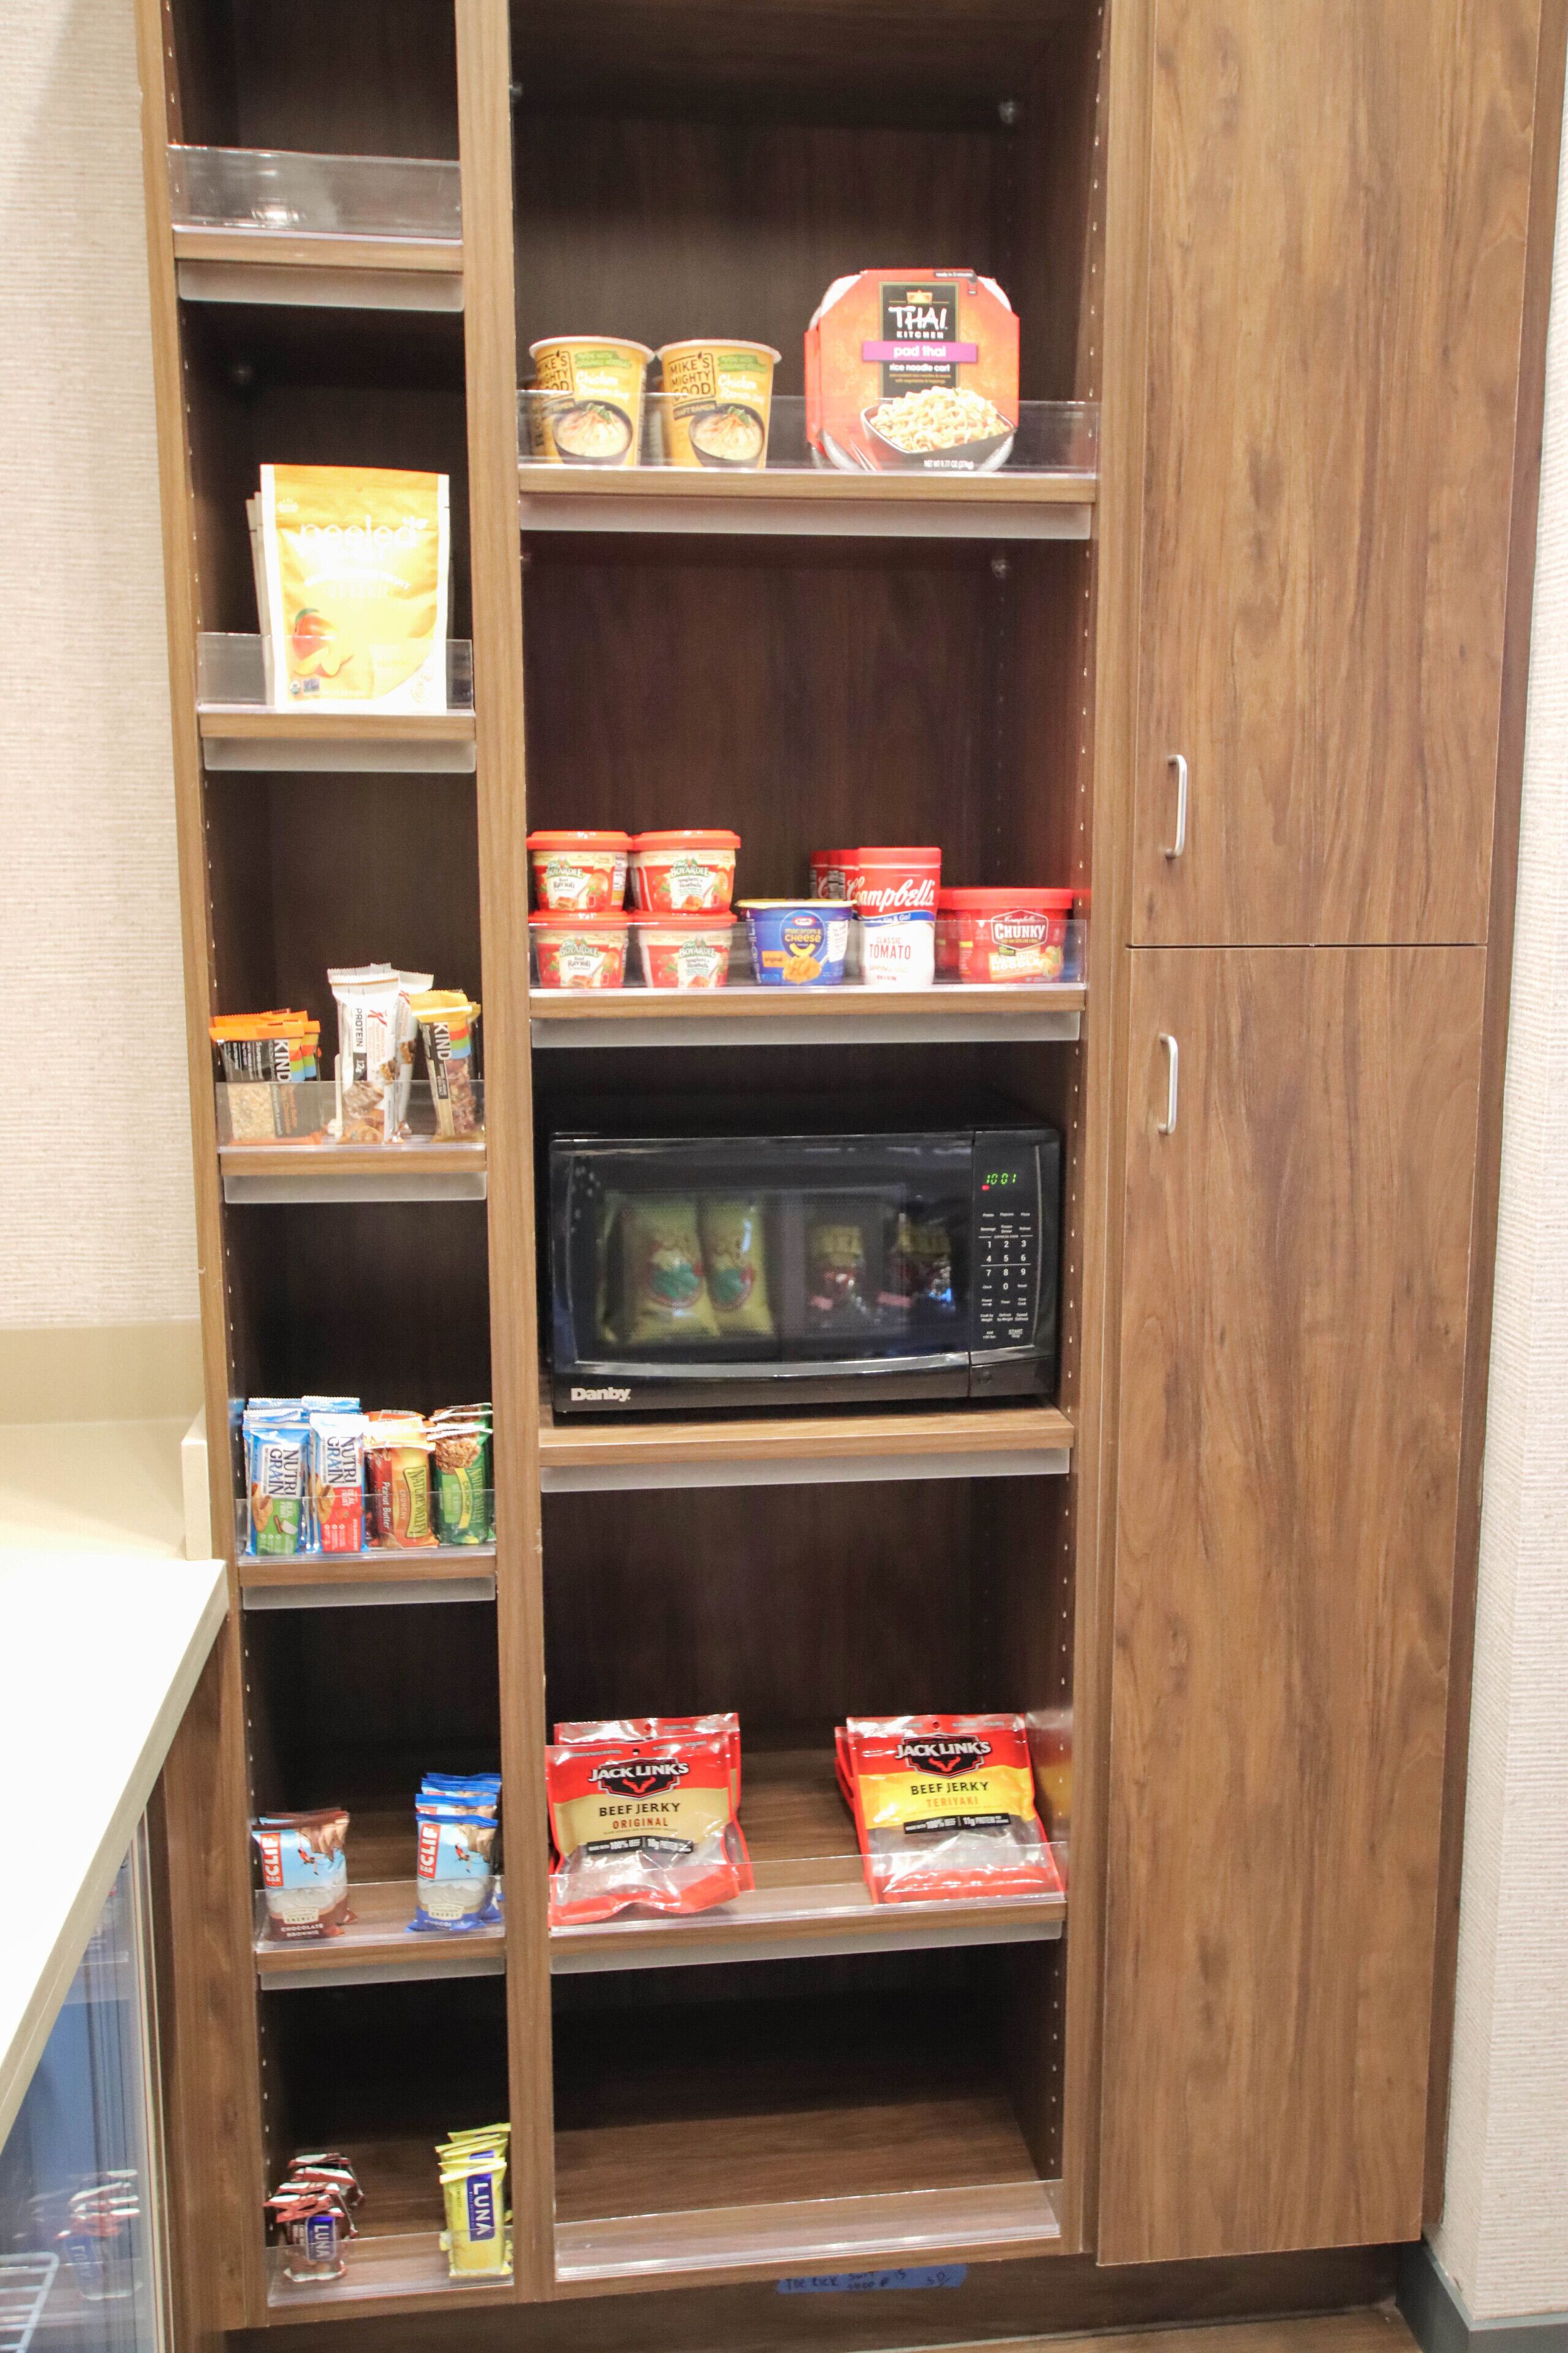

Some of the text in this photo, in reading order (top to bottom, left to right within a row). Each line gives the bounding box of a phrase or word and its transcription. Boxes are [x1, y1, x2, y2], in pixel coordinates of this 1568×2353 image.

[888, 306, 948, 330] THAI
[670, 352, 710, 374] MIKE'S
[893, 345, 947, 358] pad thai
[575, 371, 619, 387] Chicken
[672, 371, 711, 385] MIGHTY
[300, 515, 416, 558] peeled
[994, 923, 1046, 940] CHUNKY
[869, 944, 911, 960] TOMATO
[433, 1021, 452, 1061] KIND
[274, 1039, 292, 1082] KIND
[268, 1447, 285, 1495] GRAIN
[327, 1436, 344, 1484] GRAIN
[341, 1436, 357, 1483] NUTRI
[283, 1449, 299, 1496] NUTRI
[382, 1481, 392, 1529] Peanut Butter
[895, 1741, 992, 1760] JACK LINK'S
[588, 1762, 690, 1782] JACK LINK'S
[911, 1781, 989, 1795] BEEF JERKY
[599, 1802, 681, 1817] BEEF JERKY
[926, 1796, 979, 1808] TERIYAKI
[612, 1817, 668, 1830] ORIGINAL
[262, 1837, 280, 1876] CLIF
[421, 1826, 439, 1865] CLIF
[281, 1923, 324, 1932] CHOCOLATE
[472, 2182, 491, 2235] LUNA
[314, 2224, 330, 2257] LUNA
